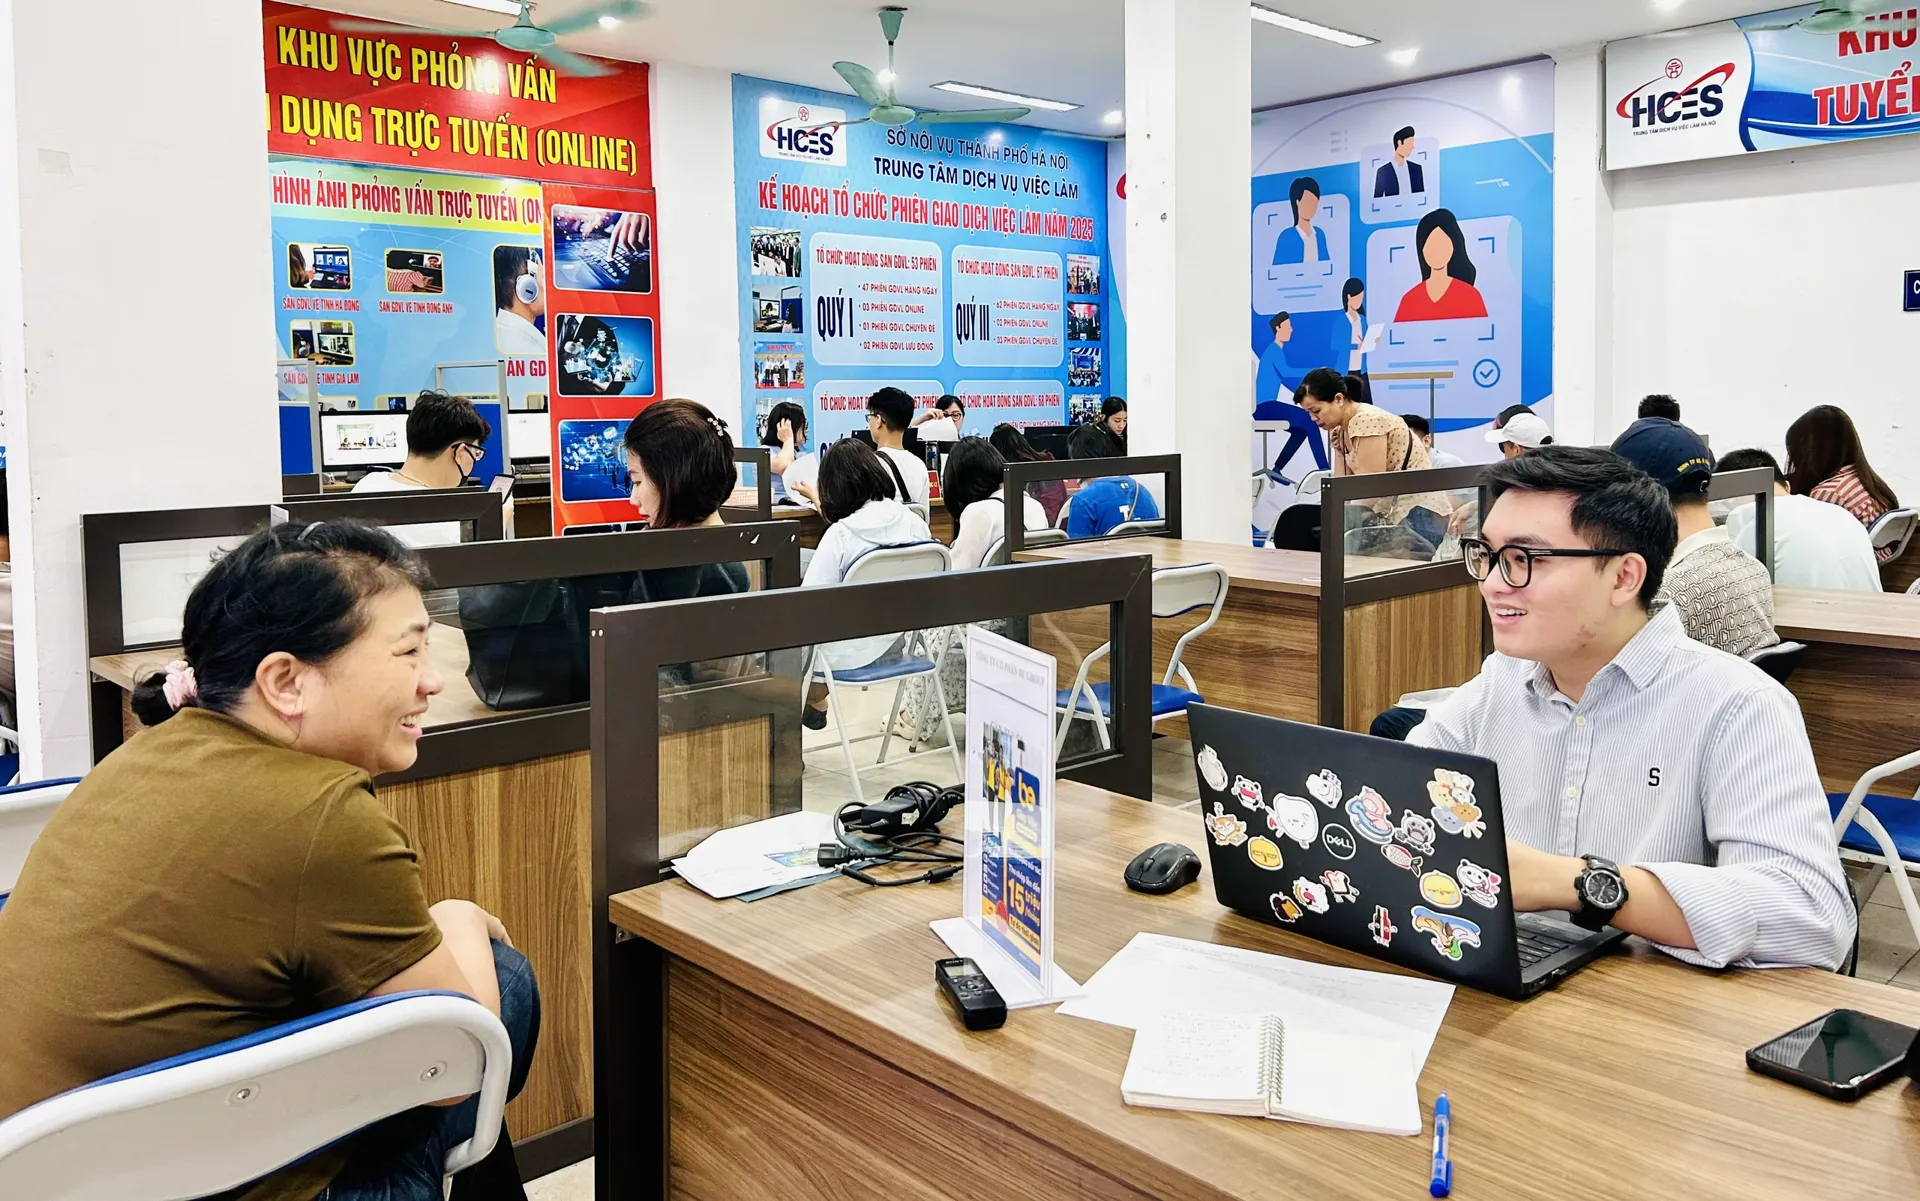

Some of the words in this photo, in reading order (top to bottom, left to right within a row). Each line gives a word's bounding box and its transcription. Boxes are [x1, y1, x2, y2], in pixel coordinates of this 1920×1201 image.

[1838, 9, 1917, 56] KHU
[278, 26, 338, 72] KHU
[346, 37, 402, 86] VỰC
[411, 42, 500, 95] PHỎNG
[507, 54, 556, 103] VẤN
[1632, 84, 1723, 128] HCES
[282, 95, 362, 145] DỤNG
[370, 107, 440, 157] TRỰC
[448, 112, 528, 160] TUYẾN
[537, 129, 636, 176] (ONLINE)
[778, 127, 833, 155] HCES
[888, 125, 906, 146] SỞ
[911, 130, 932, 152] NỘI
[937, 137, 953, 156] VỤ
[958, 139, 999, 160] THÀNH
[1004, 144, 1027, 164] PHỐ
[1032, 149, 1046, 166] HÀ
[1051, 152, 1068, 172] NỘI
[874, 157, 924, 179] TRUNG
[929, 161, 958, 184] TÂM
[963, 169, 996, 191] DỊCH
[1001, 174, 1017, 196] VỤ
[1023, 175, 1050, 199] VIỆC
[1055, 178, 1078, 199] LÀM
[273, 170, 311, 206] HÌNH
[317, 170, 347, 208] ẢNH
[352, 176, 401, 213] PHỎNG
[405, 179, 434, 215] VẤN
[437, 190, 472, 223] TRỰC
[476, 188, 517, 222] TUYẾN
[759, 174, 778, 209] KẾ
[782, 184, 828, 219] HOẠCH
[833, 180, 849, 216] TỔ
[853, 189, 887, 221] CHỨC
[891, 194, 928, 224] PHIÊN
[932, 201, 959, 228] GIAO
[963, 205, 989, 234] DỊCH
[992, 204, 1015, 237] VIỆC
[1020, 206, 1041, 235] LÀM
[1045, 209, 1067, 238] NĂM
[1070, 218, 1093, 240] 2025
[816, 244, 825, 264] TỔ
[826, 248, 843, 265] CHỨC
[845, 250, 860, 269] HOẠT
[862, 250, 878, 270] ĐỘNG
[880, 252, 892, 269] SÀN
[894, 255, 910, 269] GDVL:
[911, 256, 919, 270] 53
[920, 255, 937, 272] PHIÊN
[981, 262, 994, 278] HOẠT
[862, 283, 869, 292] 47
[871, 282, 887, 293] PHIÊN
[888, 285, 903, 294] GDVL
[905, 284, 921, 295] HÀNG
[297, 297, 310, 310] GDVL
[321, 298, 334, 310] TINH
[392, 301, 404, 313] GDVL
[413, 302, 425, 313] TINH
[442, 303, 452, 313] ANH
[817, 288, 844, 342] QUÝ
[849, 298, 854, 338] I
[862, 302, 870, 311] 03
[871, 301, 887, 312] PHIÊN
[889, 304, 904, 312] GDVL
[905, 304, 924, 314] ONLINE
[863, 322, 870, 330] 01
[872, 320, 888, 331] PHIÊN
[889, 323, 904, 331] GDVL
[906, 322, 927, 332] CHUYÊN
[956, 296, 976, 344] QUÝ
[980, 305, 989, 341] III
[864, 342, 870, 350] 02
[872, 340, 888, 350] PHIÊN
[890, 342, 904, 350] GDVL
[298, 373, 308, 384] GDV
[322, 373, 334, 384] TINH
[336, 373, 345, 384] GIA
[507, 357, 525, 376] ÀN
[830, 393, 846, 410] CHỨC
[848, 396, 863, 413] HOẠT
[983, 395, 996, 410] HOẠT
[1648, 767, 1660, 786] S
[1326, 834, 1353, 849] DELL
[1008, 878, 1025, 914] 15
[1025, 889, 1040, 910] triệu
